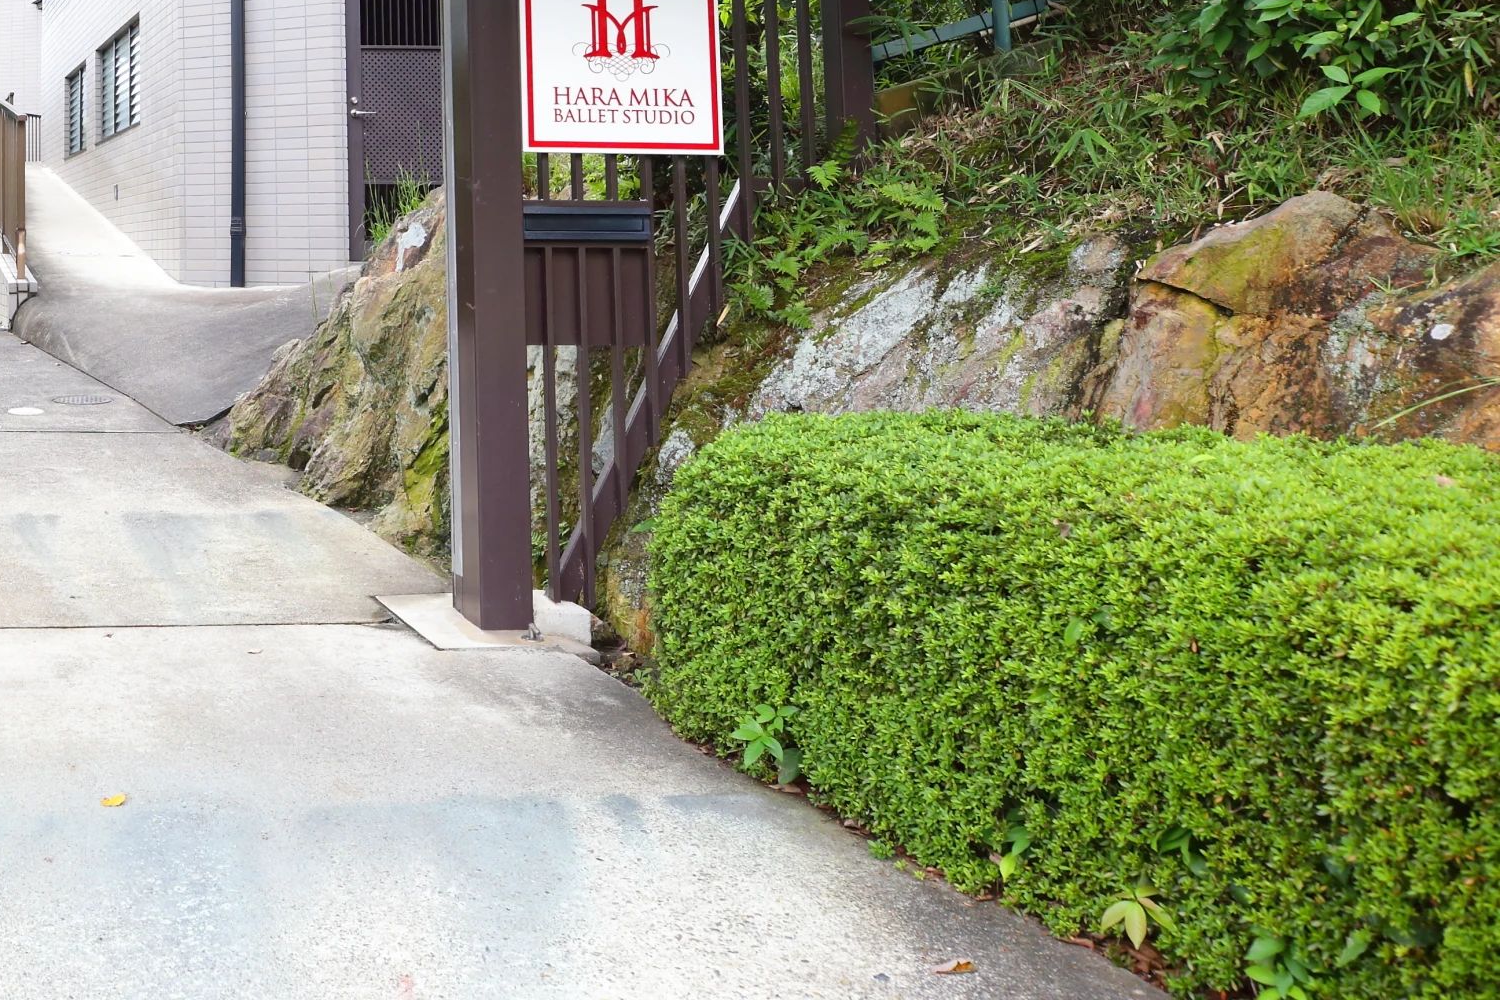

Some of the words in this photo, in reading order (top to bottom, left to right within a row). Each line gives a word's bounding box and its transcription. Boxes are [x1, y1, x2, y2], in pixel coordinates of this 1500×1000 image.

[553, 86, 623, 107] HARA
[628, 87, 695, 108] MIKA
[553, 108, 619, 124] BALLET
[622, 109, 695, 125] STUDIO
